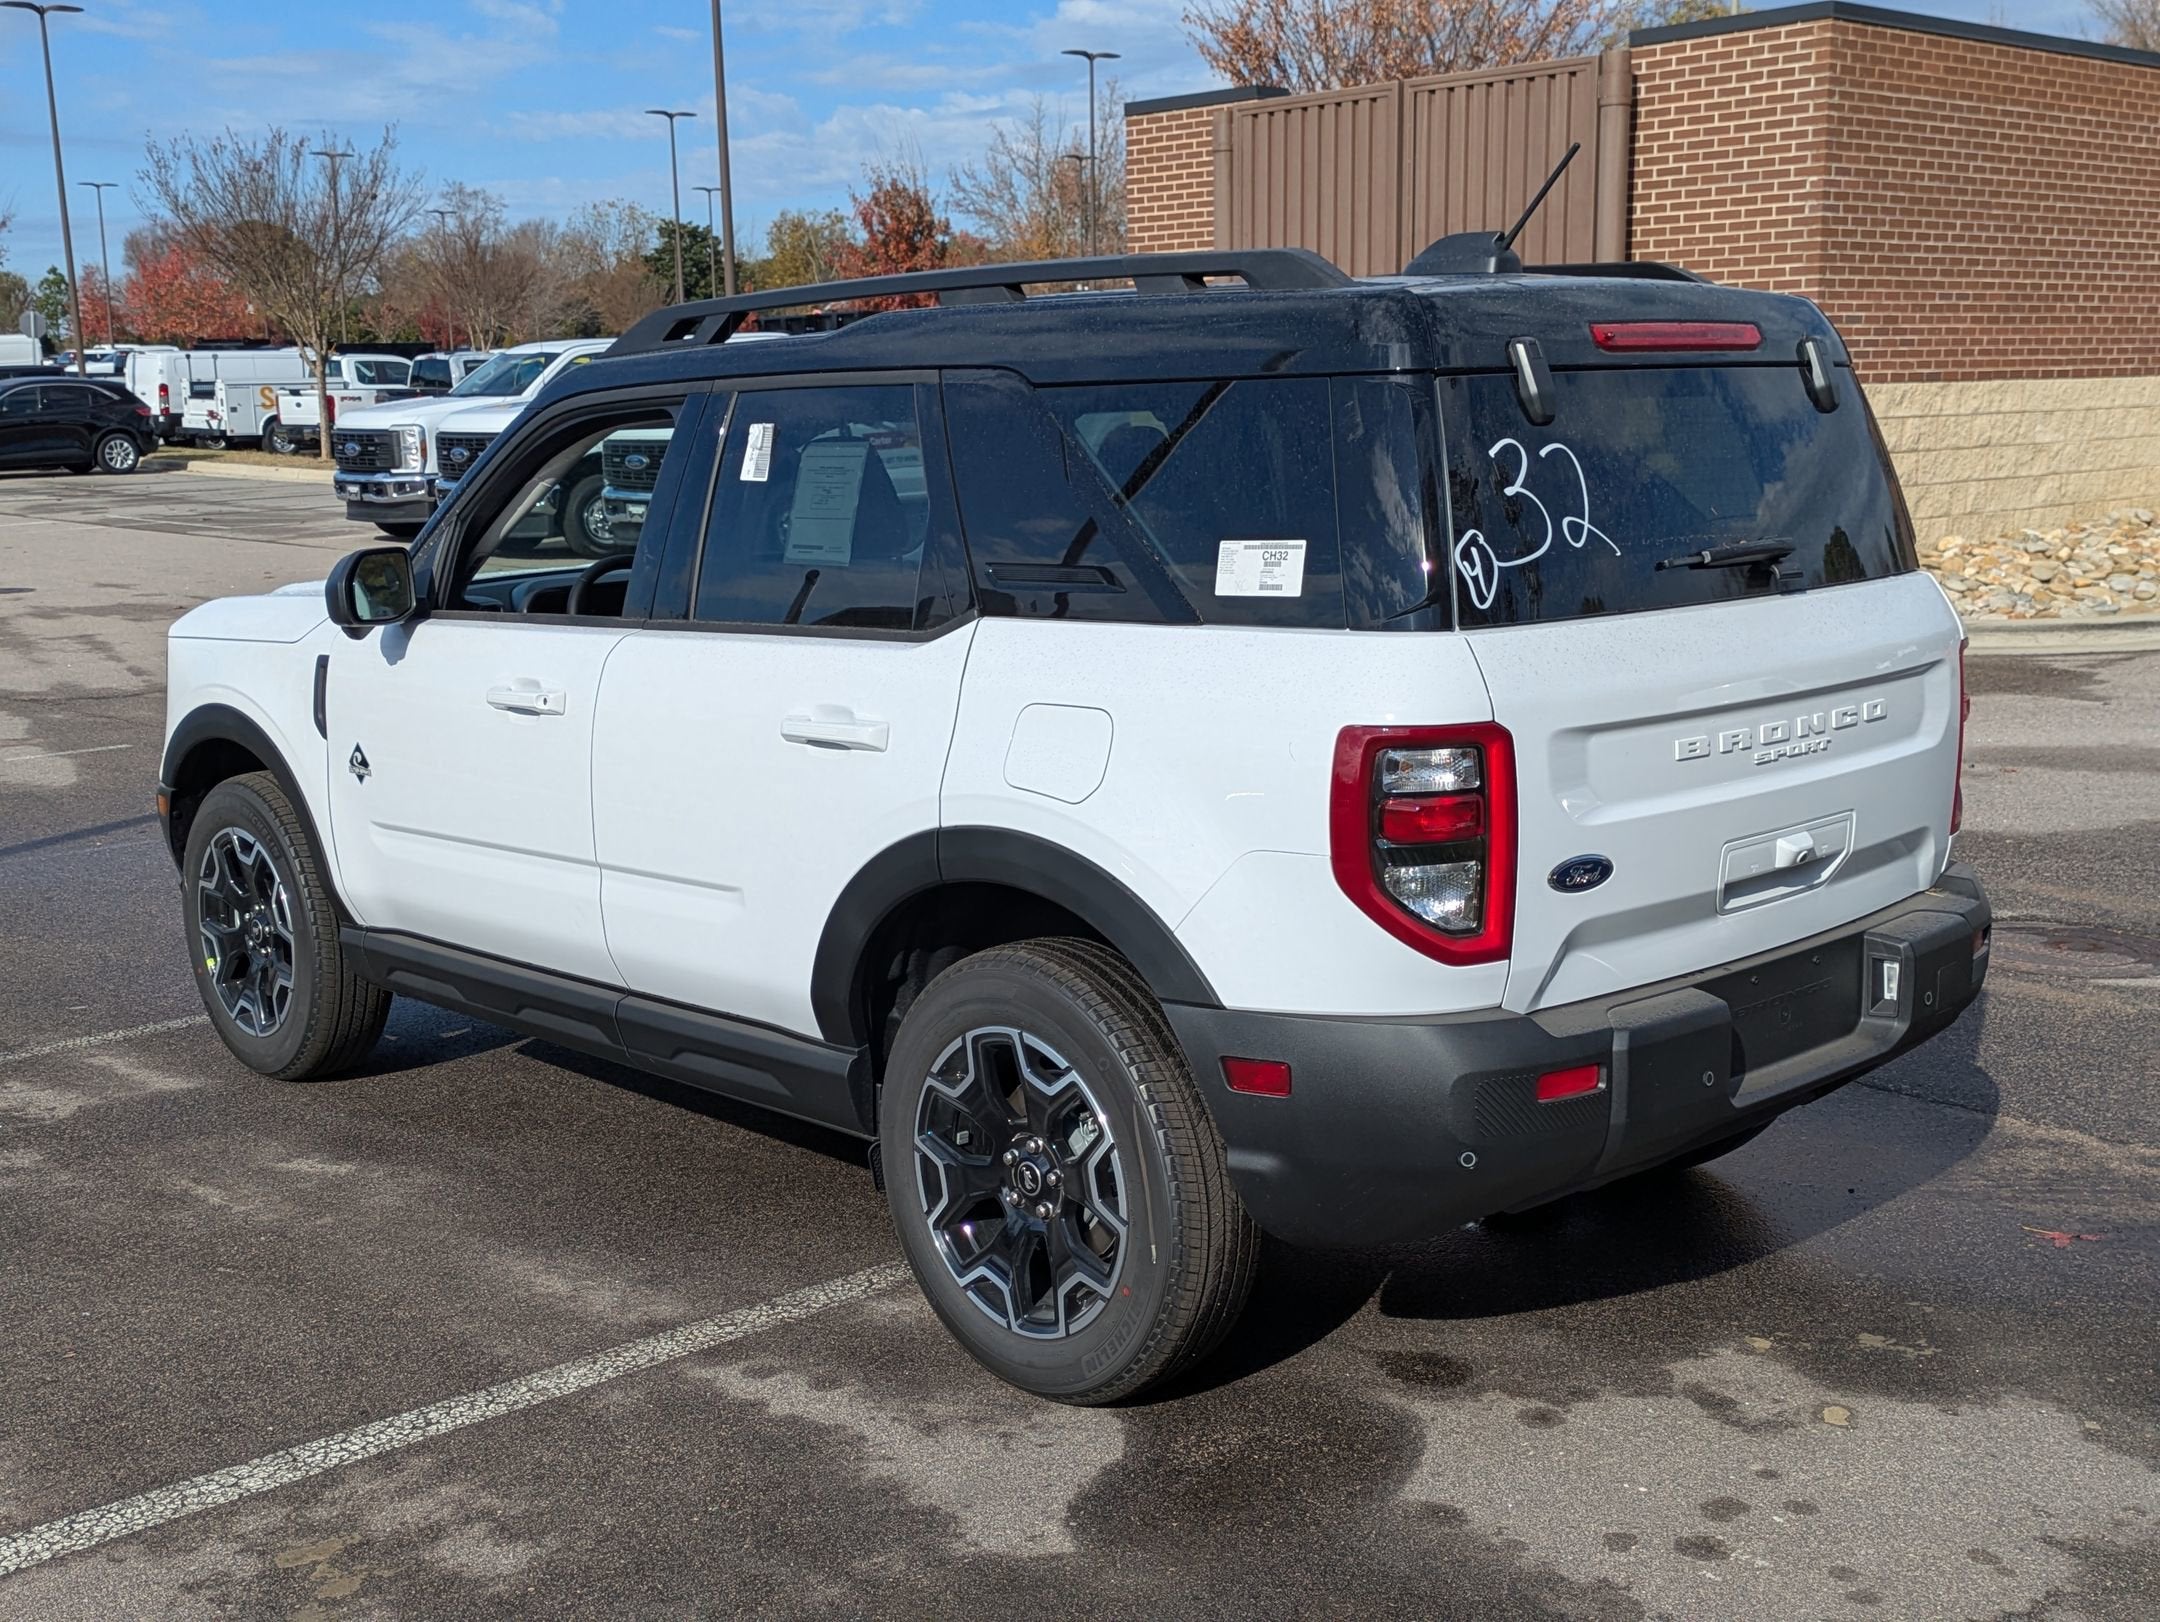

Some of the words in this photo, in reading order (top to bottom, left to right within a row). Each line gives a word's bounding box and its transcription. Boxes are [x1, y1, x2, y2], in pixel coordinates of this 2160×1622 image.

[1488, 437, 1622, 567] 32
[1261, 550, 1290, 561] CH32
[1674, 697, 1888, 762] BRONCO
[1753, 736, 1832, 765] SPORT
[1565, 863, 1602, 887] Ford
